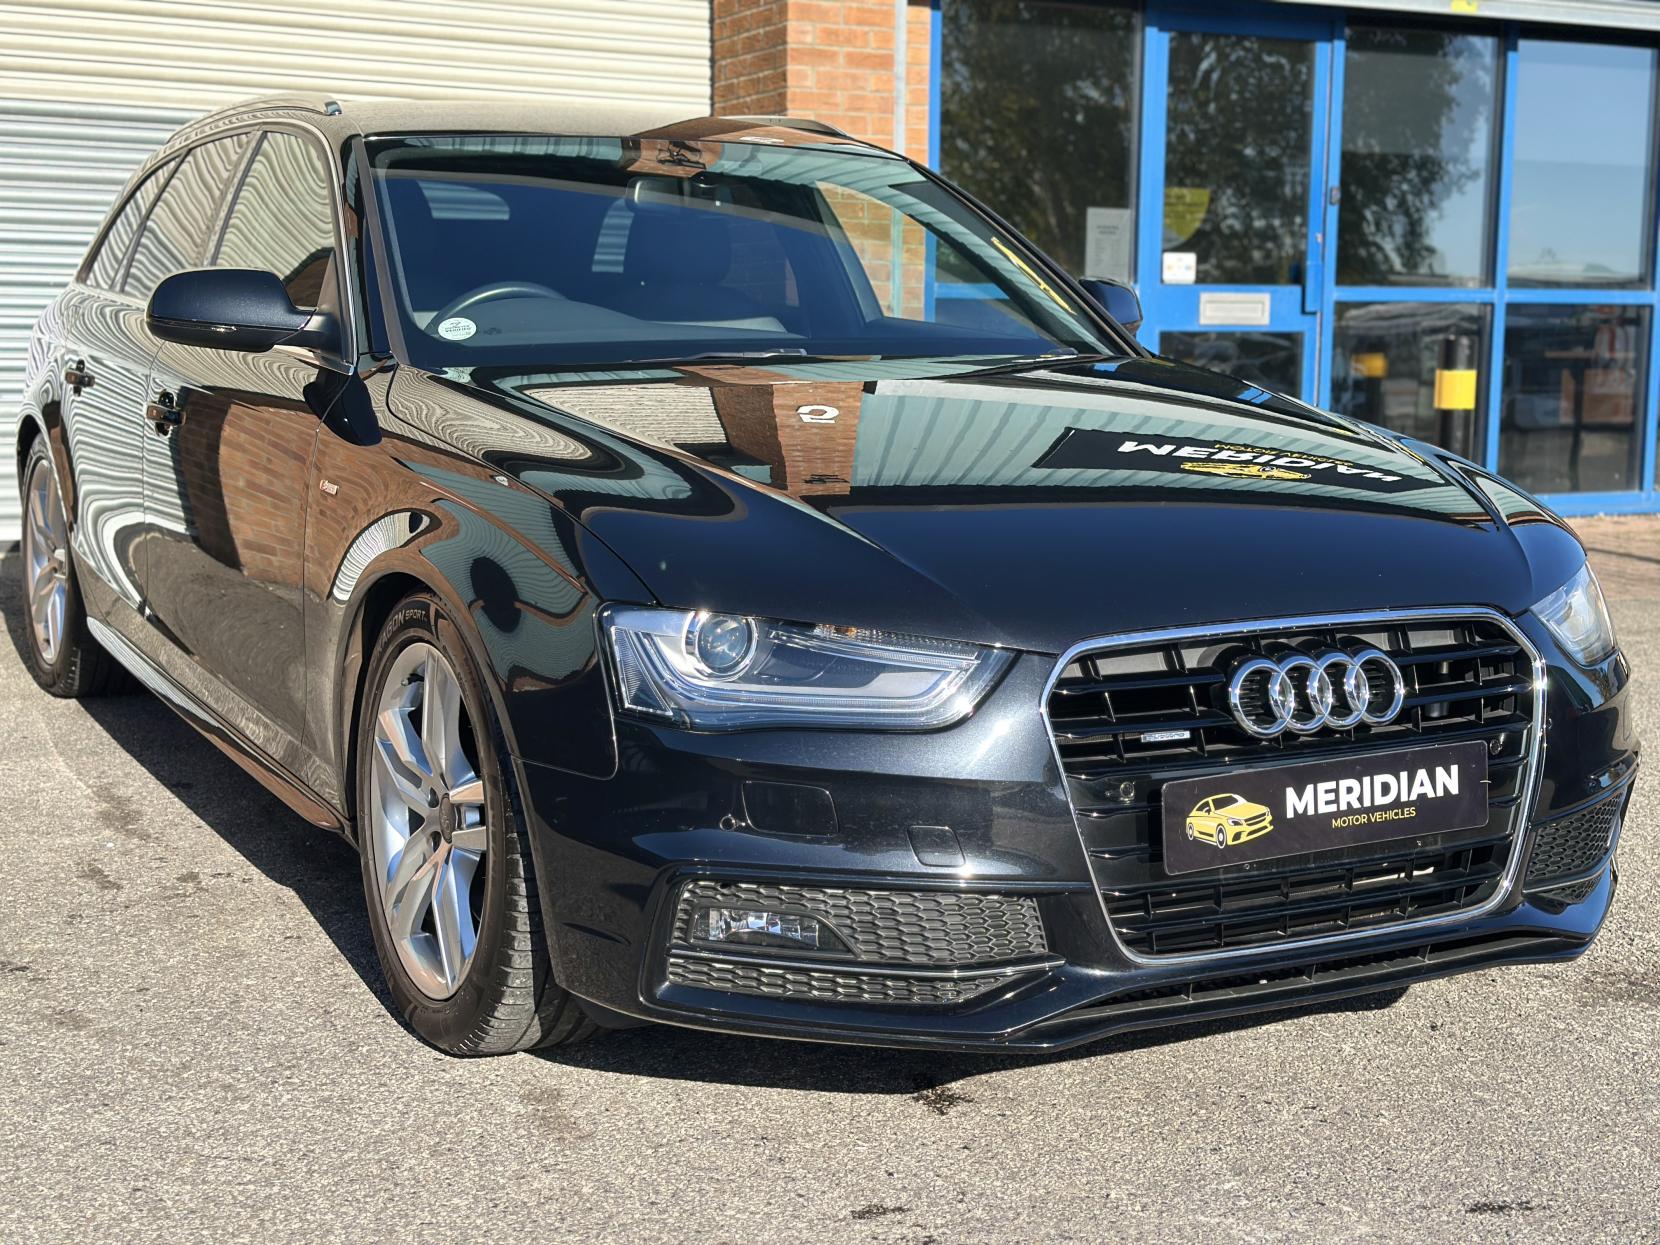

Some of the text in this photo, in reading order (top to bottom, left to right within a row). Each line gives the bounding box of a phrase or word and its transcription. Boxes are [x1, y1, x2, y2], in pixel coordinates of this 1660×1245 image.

[405, 609, 426, 622] SPORT
[1285, 764, 1460, 819] MERIDIAN
[1332, 806, 1416, 829] MOTOR VEHICLES
